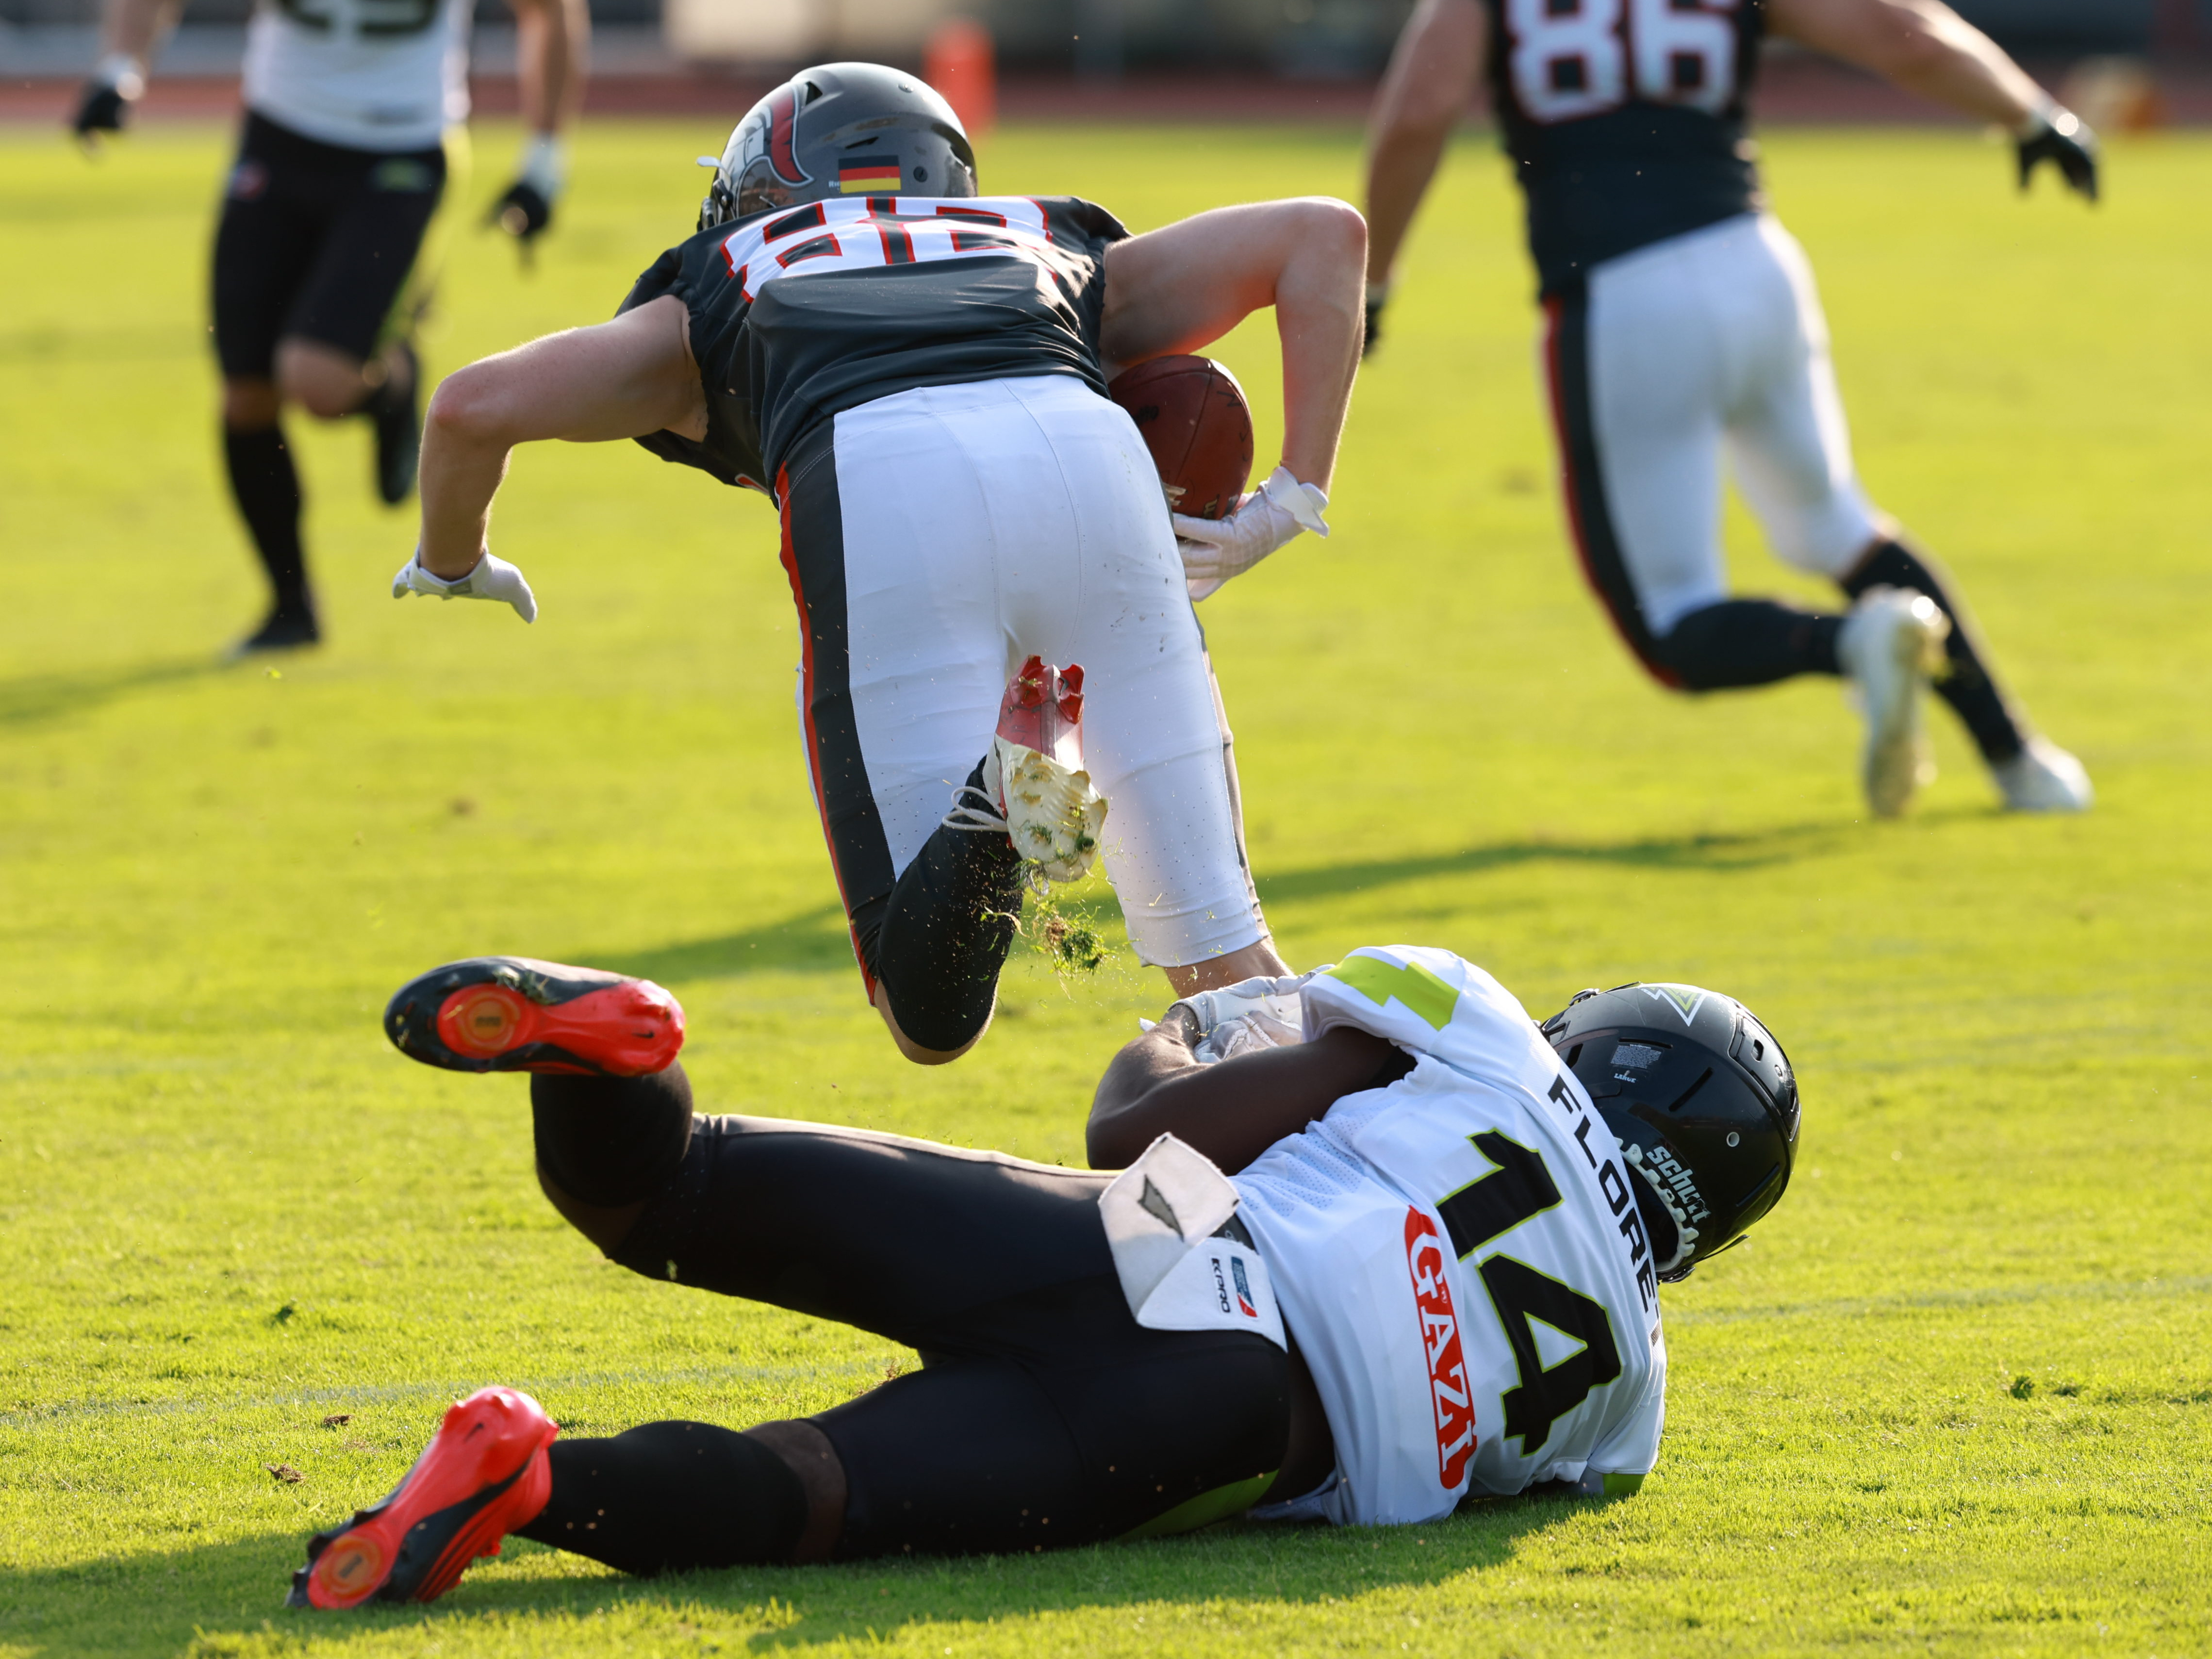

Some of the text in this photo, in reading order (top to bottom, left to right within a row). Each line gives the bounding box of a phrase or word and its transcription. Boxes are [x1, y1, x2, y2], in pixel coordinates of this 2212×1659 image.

[1504, 0, 1739, 124] 86
[1614, 1073, 1636, 1083] LARGE
[1410, 1232, 1473, 1472] GAZI
[1435, 1127, 1622, 1457] 14
